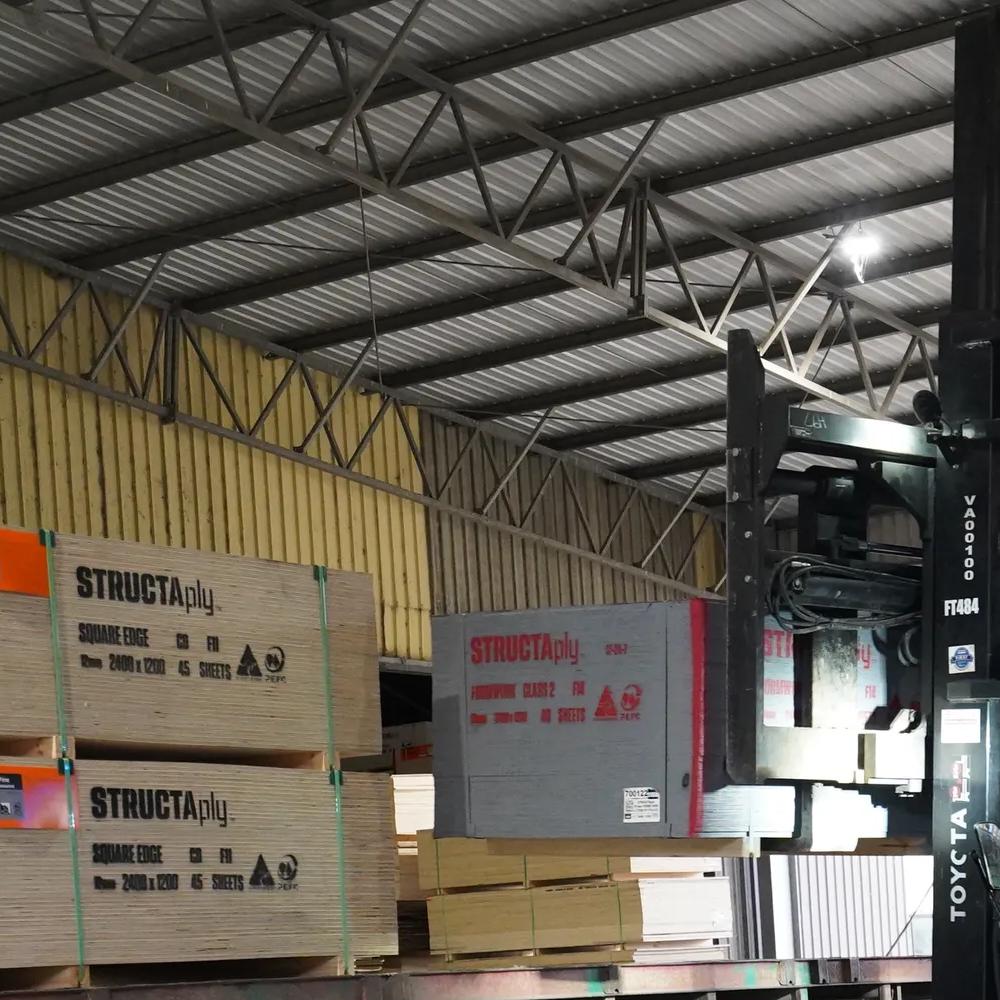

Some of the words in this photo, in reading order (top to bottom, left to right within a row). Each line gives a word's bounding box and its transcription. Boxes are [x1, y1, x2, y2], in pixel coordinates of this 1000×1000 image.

[963, 494, 977, 581] VA00100
[76, 565, 215, 616] STRUCTAply
[944, 597, 980, 616] FT484
[79, 622, 122, 645] SQUARE
[123, 626, 149, 648] EDGE
[470, 631, 580, 666] STRUCTAply
[109, 653, 134, 673] 2400
[143, 657, 166, 675] 1200
[178, 660, 190, 677] 45
[199, 661, 232, 680] SHEETS
[90, 786, 228, 828] STRUCTAply
[92, 843, 135, 865] SQUARE
[136, 844, 163, 864] EDGE
[122, 874, 147, 891] 2400
[156, 874, 179, 891] 1200
[191, 874, 204, 890] 45
[212, 874, 245, 891] SHEETS
